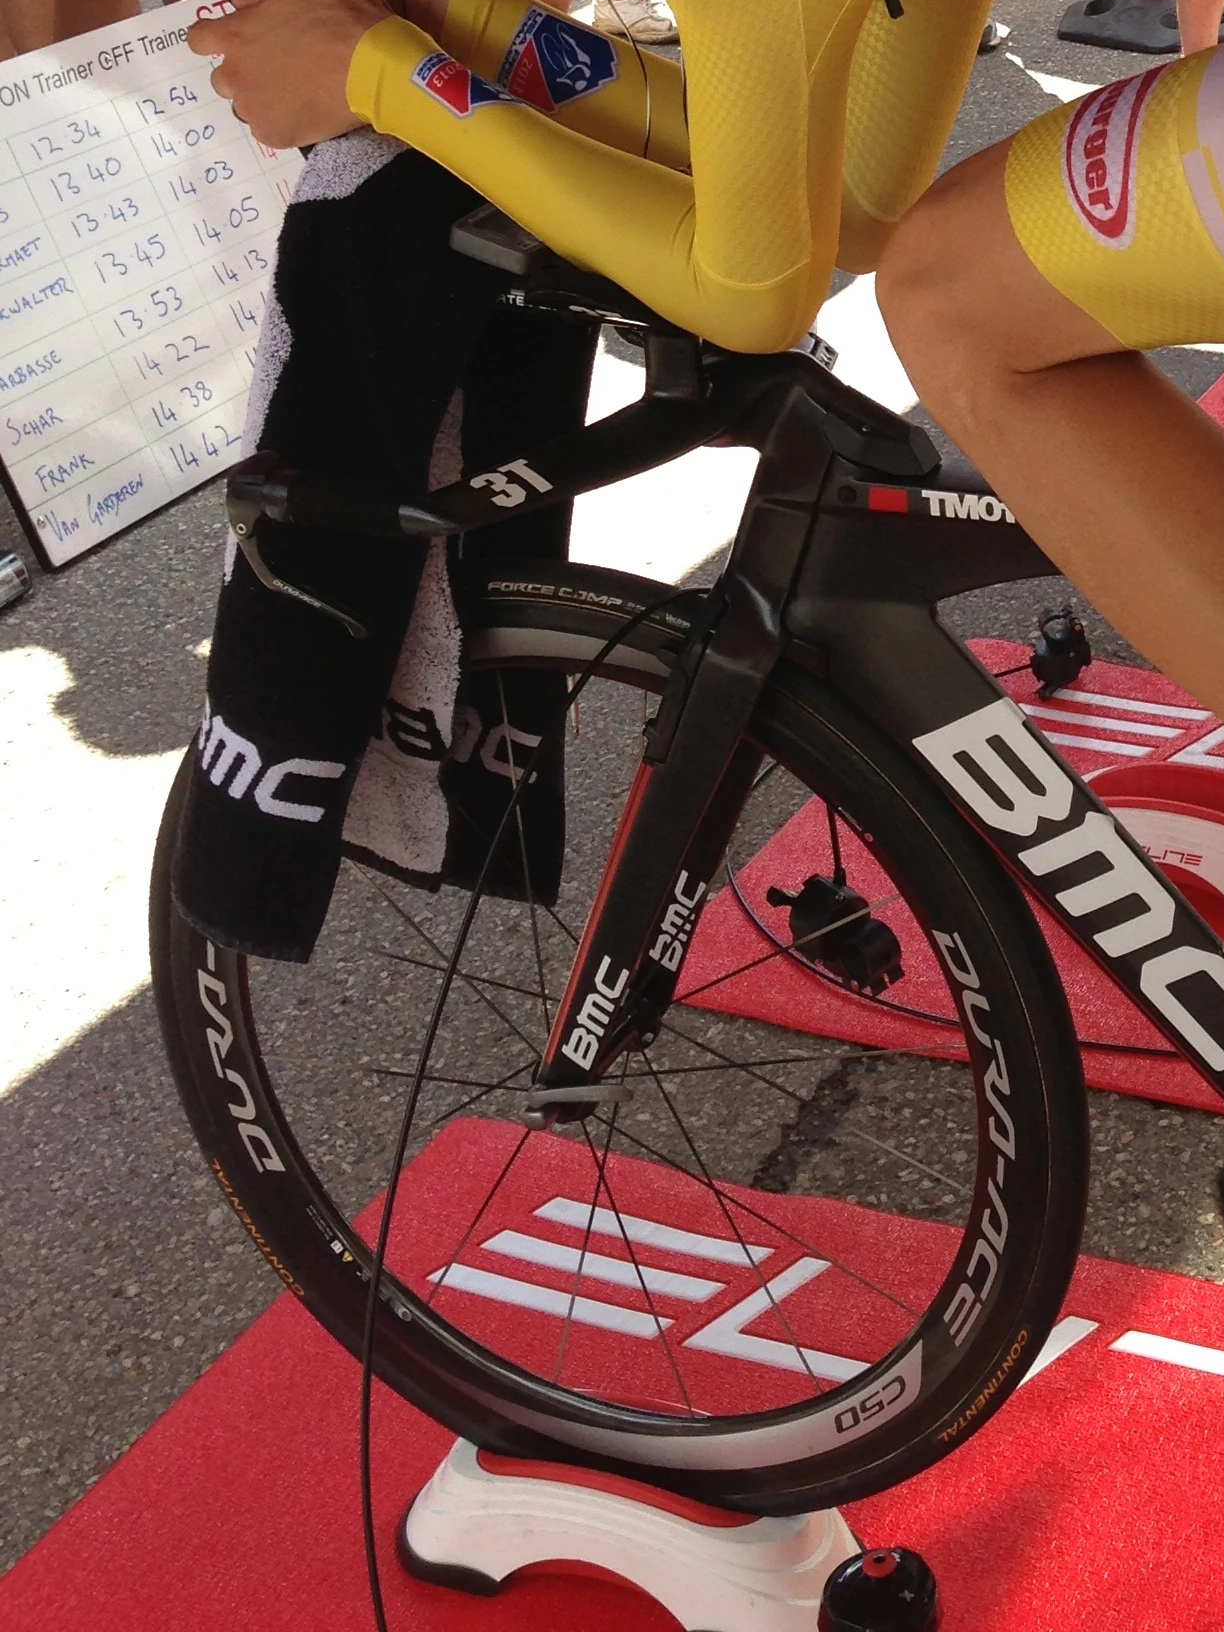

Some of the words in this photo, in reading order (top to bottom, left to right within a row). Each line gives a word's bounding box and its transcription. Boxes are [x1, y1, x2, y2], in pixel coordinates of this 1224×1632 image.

[33, 61, 94, 94] Trainer
[137, 25, 189, 56] Traine
[469, 458, 554, 509] 3T
[487, 580, 556, 595] FORCE
[558, 585, 623, 607] COMP
[649, 869, 707, 972] BMC
[561, 955, 630, 1073] BMC
[834, 1375, 908, 1436] C50
[937, 1328, 1031, 1446] CONTINENTAL
